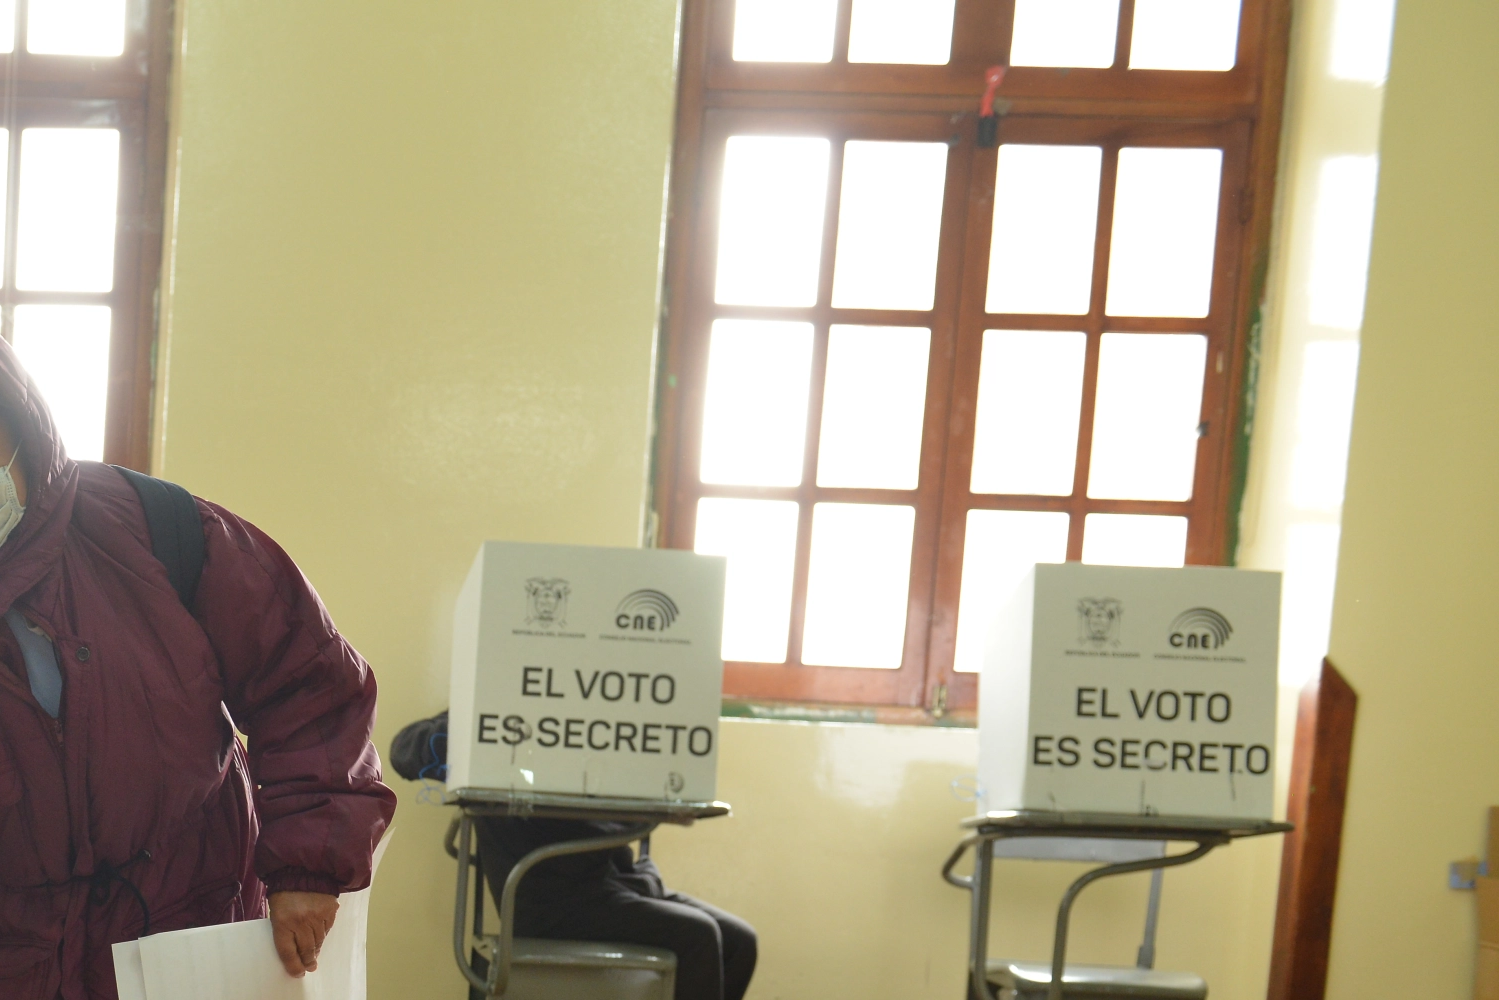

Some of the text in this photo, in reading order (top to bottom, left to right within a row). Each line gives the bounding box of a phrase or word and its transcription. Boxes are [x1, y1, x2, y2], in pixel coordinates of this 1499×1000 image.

[521, 666, 675, 704] EL VOTO
[1076, 687, 1232, 723] EL VOTO
[477, 713, 712, 757] ES SECRETO
[1033, 735, 1270, 775] ES SECRETO
